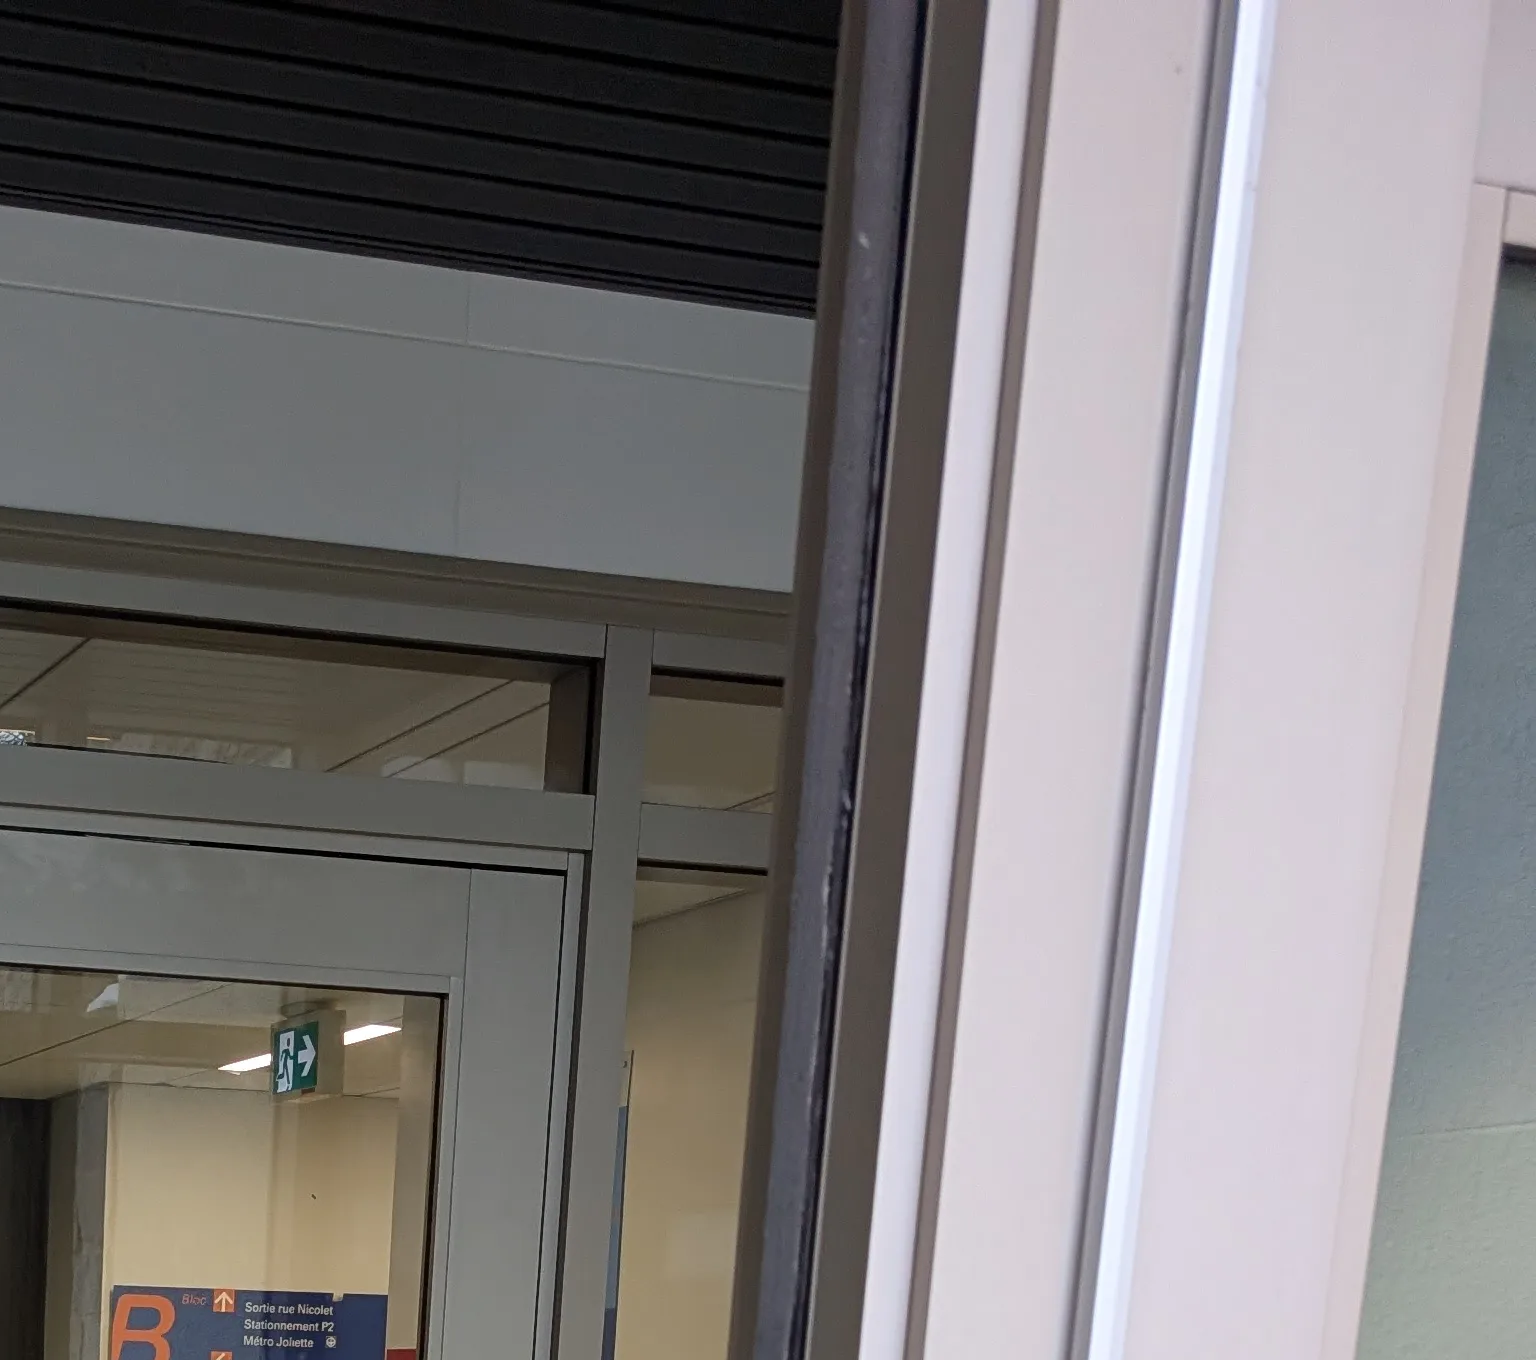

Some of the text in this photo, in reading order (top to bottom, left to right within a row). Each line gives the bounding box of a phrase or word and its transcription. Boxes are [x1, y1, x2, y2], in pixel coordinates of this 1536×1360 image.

[181, 1293, 207, 1306] Bloc
[244, 1301, 334, 1316] Sortie rue Nicolet
[243, 1318, 335, 1333] Stationnement P2
[243, 1335, 314, 1348] Métro Joliette
